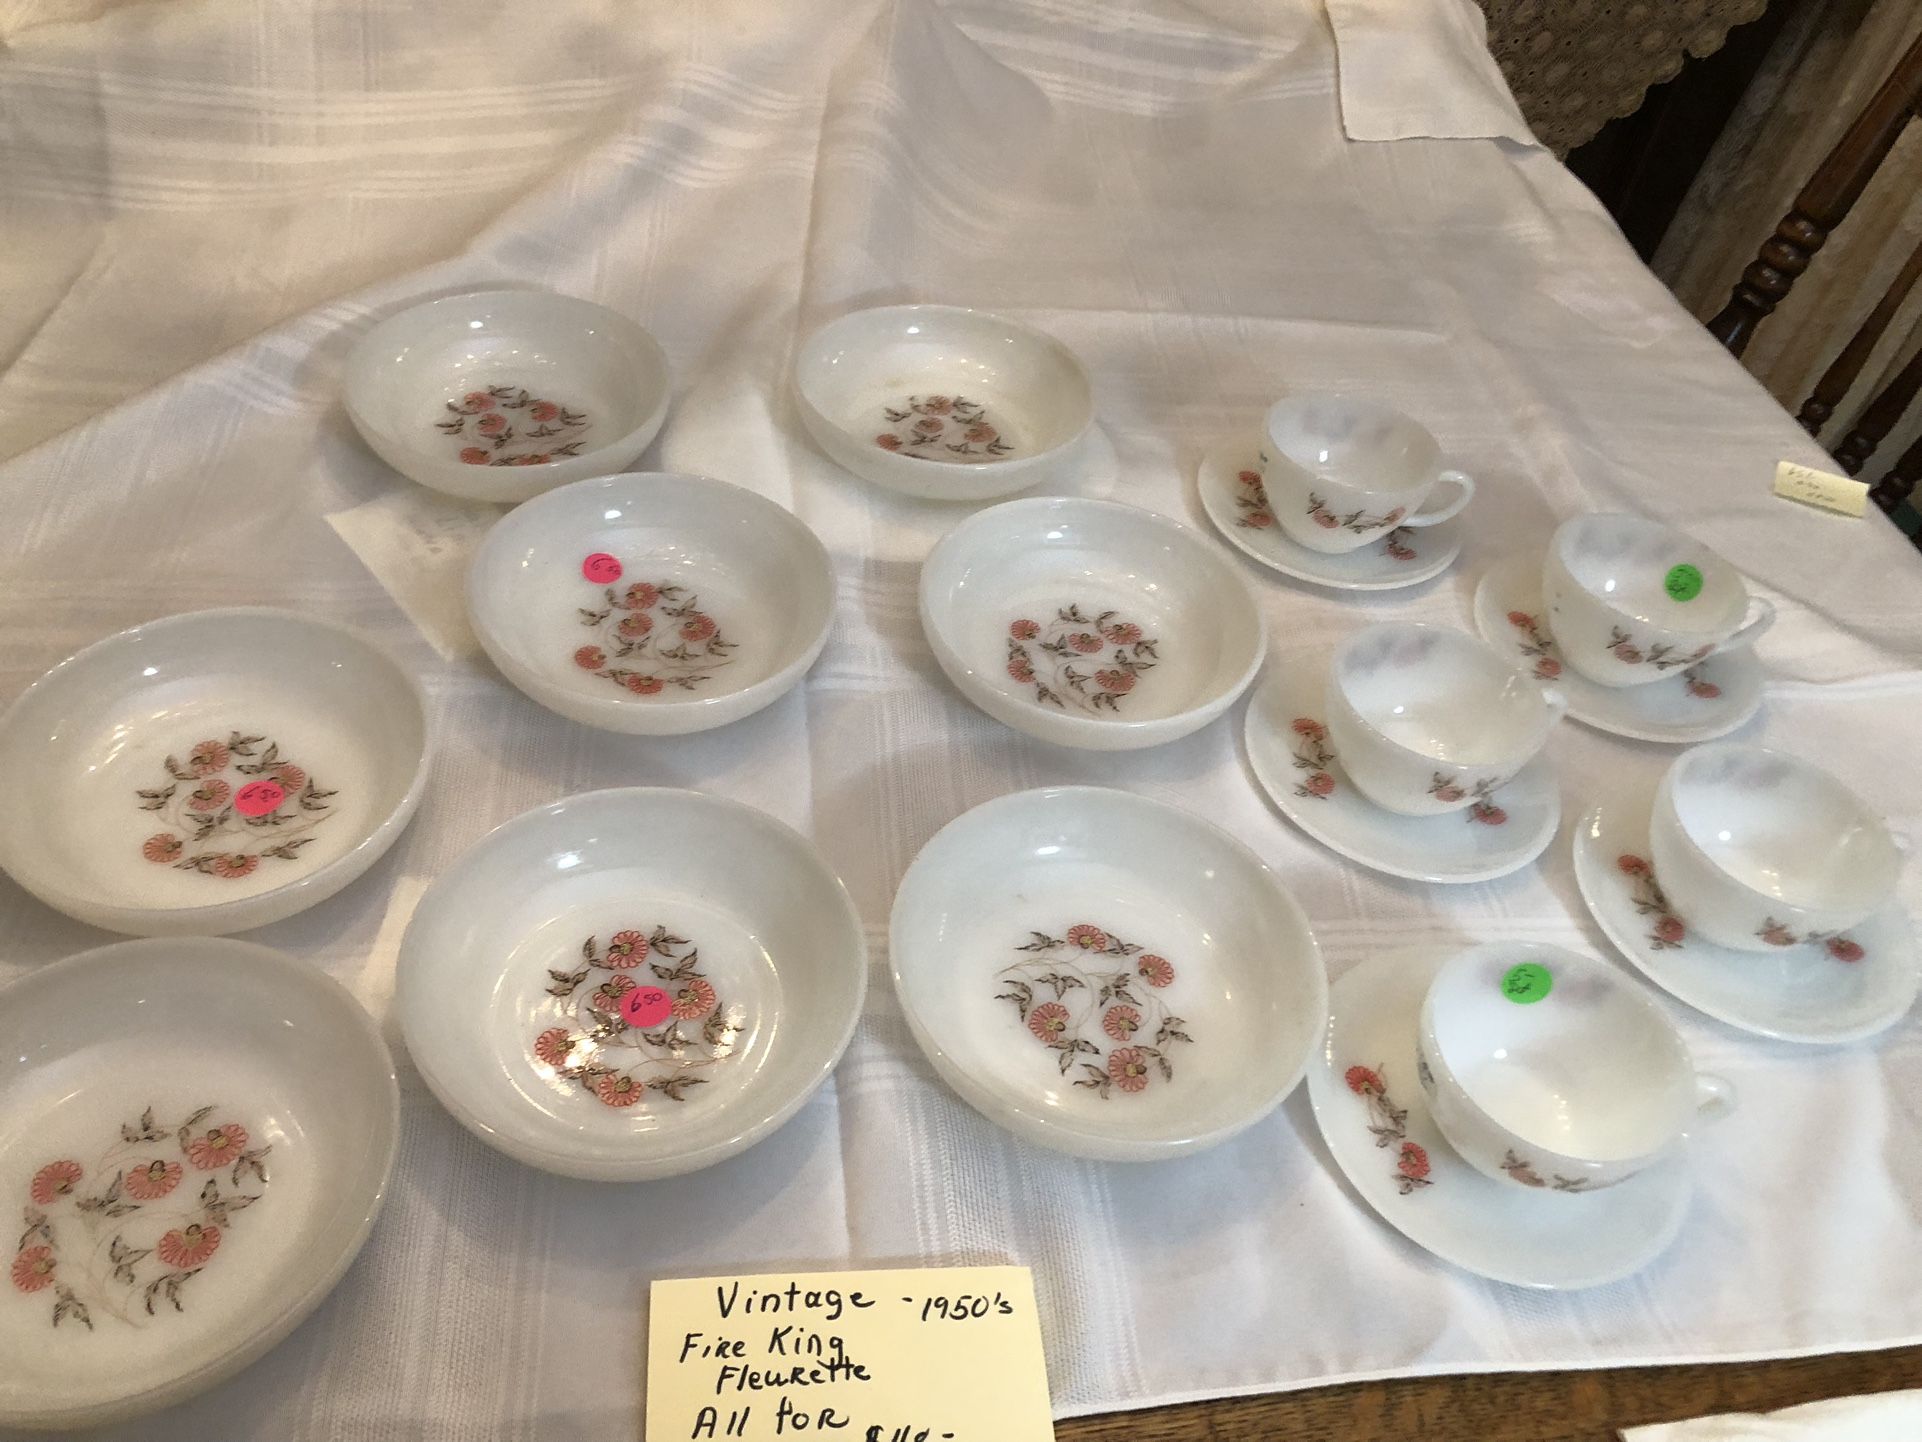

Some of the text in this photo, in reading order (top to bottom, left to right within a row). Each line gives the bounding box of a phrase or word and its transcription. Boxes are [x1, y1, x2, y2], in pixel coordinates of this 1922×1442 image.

[717, 1281, 876, 1321] Vintage
[768, 1325, 845, 1371] King
[691, 1405, 751, 1440] All
